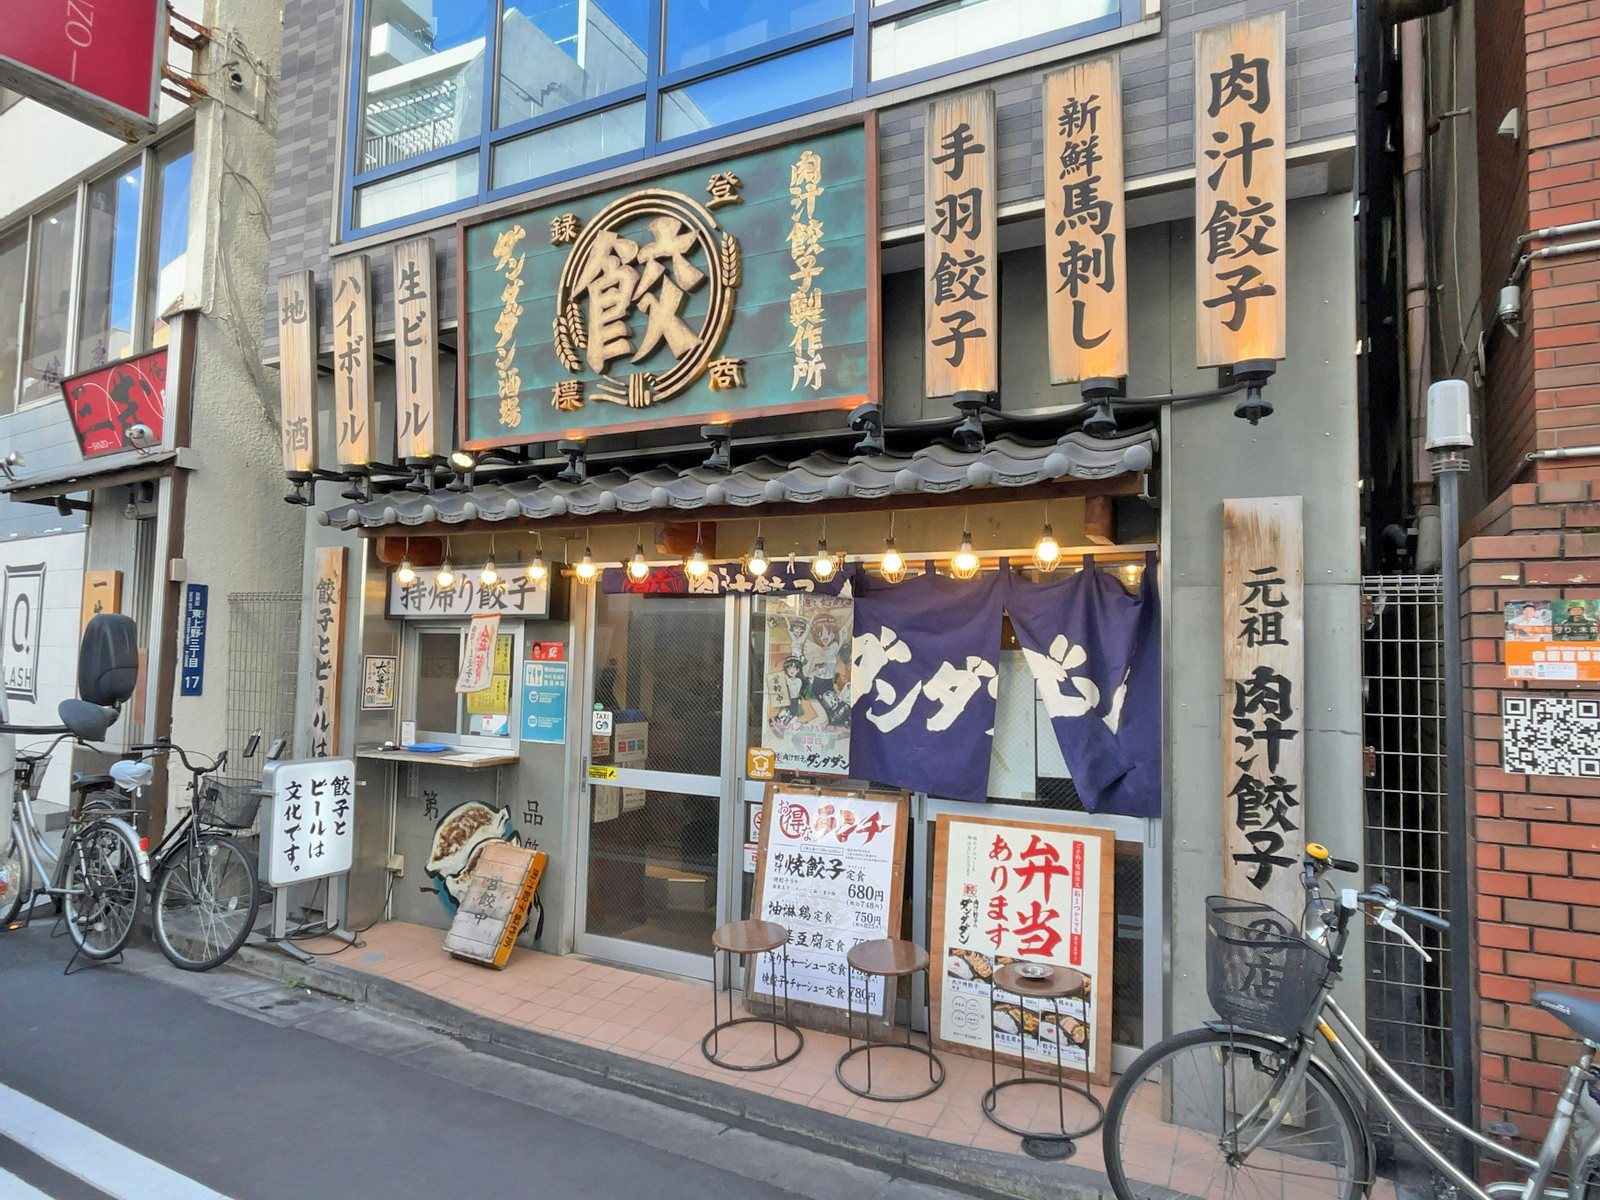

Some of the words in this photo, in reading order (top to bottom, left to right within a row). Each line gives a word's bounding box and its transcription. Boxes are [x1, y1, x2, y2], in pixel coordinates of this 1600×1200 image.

[65, 0, 94, 47] ZO
[549, 213, 580, 246] 録
[705, 171, 744, 210] 登
[1055, 95, 1117, 349] 新鮮馬刺し
[1201, 53, 1280, 331] 肉汁餃子
[786, 150, 827, 392] 肉汁餃子製作所
[930, 123, 988, 368] 手羽餃子
[569, 216, 709, 375] 餃
[281, 290, 309, 453] 地酒
[334, 276, 365, 447] ハイボール
[398, 262, 430, 439] 生ビール
[708, 356, 747, 392] 商
[551, 380, 586, 412] 標
[12, 592, 30, 655] Q
[400, 573, 536, 612] 持帰り餃子
[1238, 566, 1290, 649] 元祖
[189, 609, 201, 668] 東上野三丁目
[311, 578, 337, 757] 餃子とビールは
[185, 676, 200, 689] 17
[595, 721, 609, 731] GO
[308, 778, 327, 859] ビールは
[330, 775, 351, 836] 餃子と
[1227, 665, 1299, 892] 肉汁餃子
[283, 780, 303, 872] 文化です。
[812, 804, 892, 846] ランチ
[848, 884, 884, 903] 680円
[855, 911, 881, 926] 750円
[984, 834, 1013, 951] あります
[1012, 834, 1070, 958] 弁当
